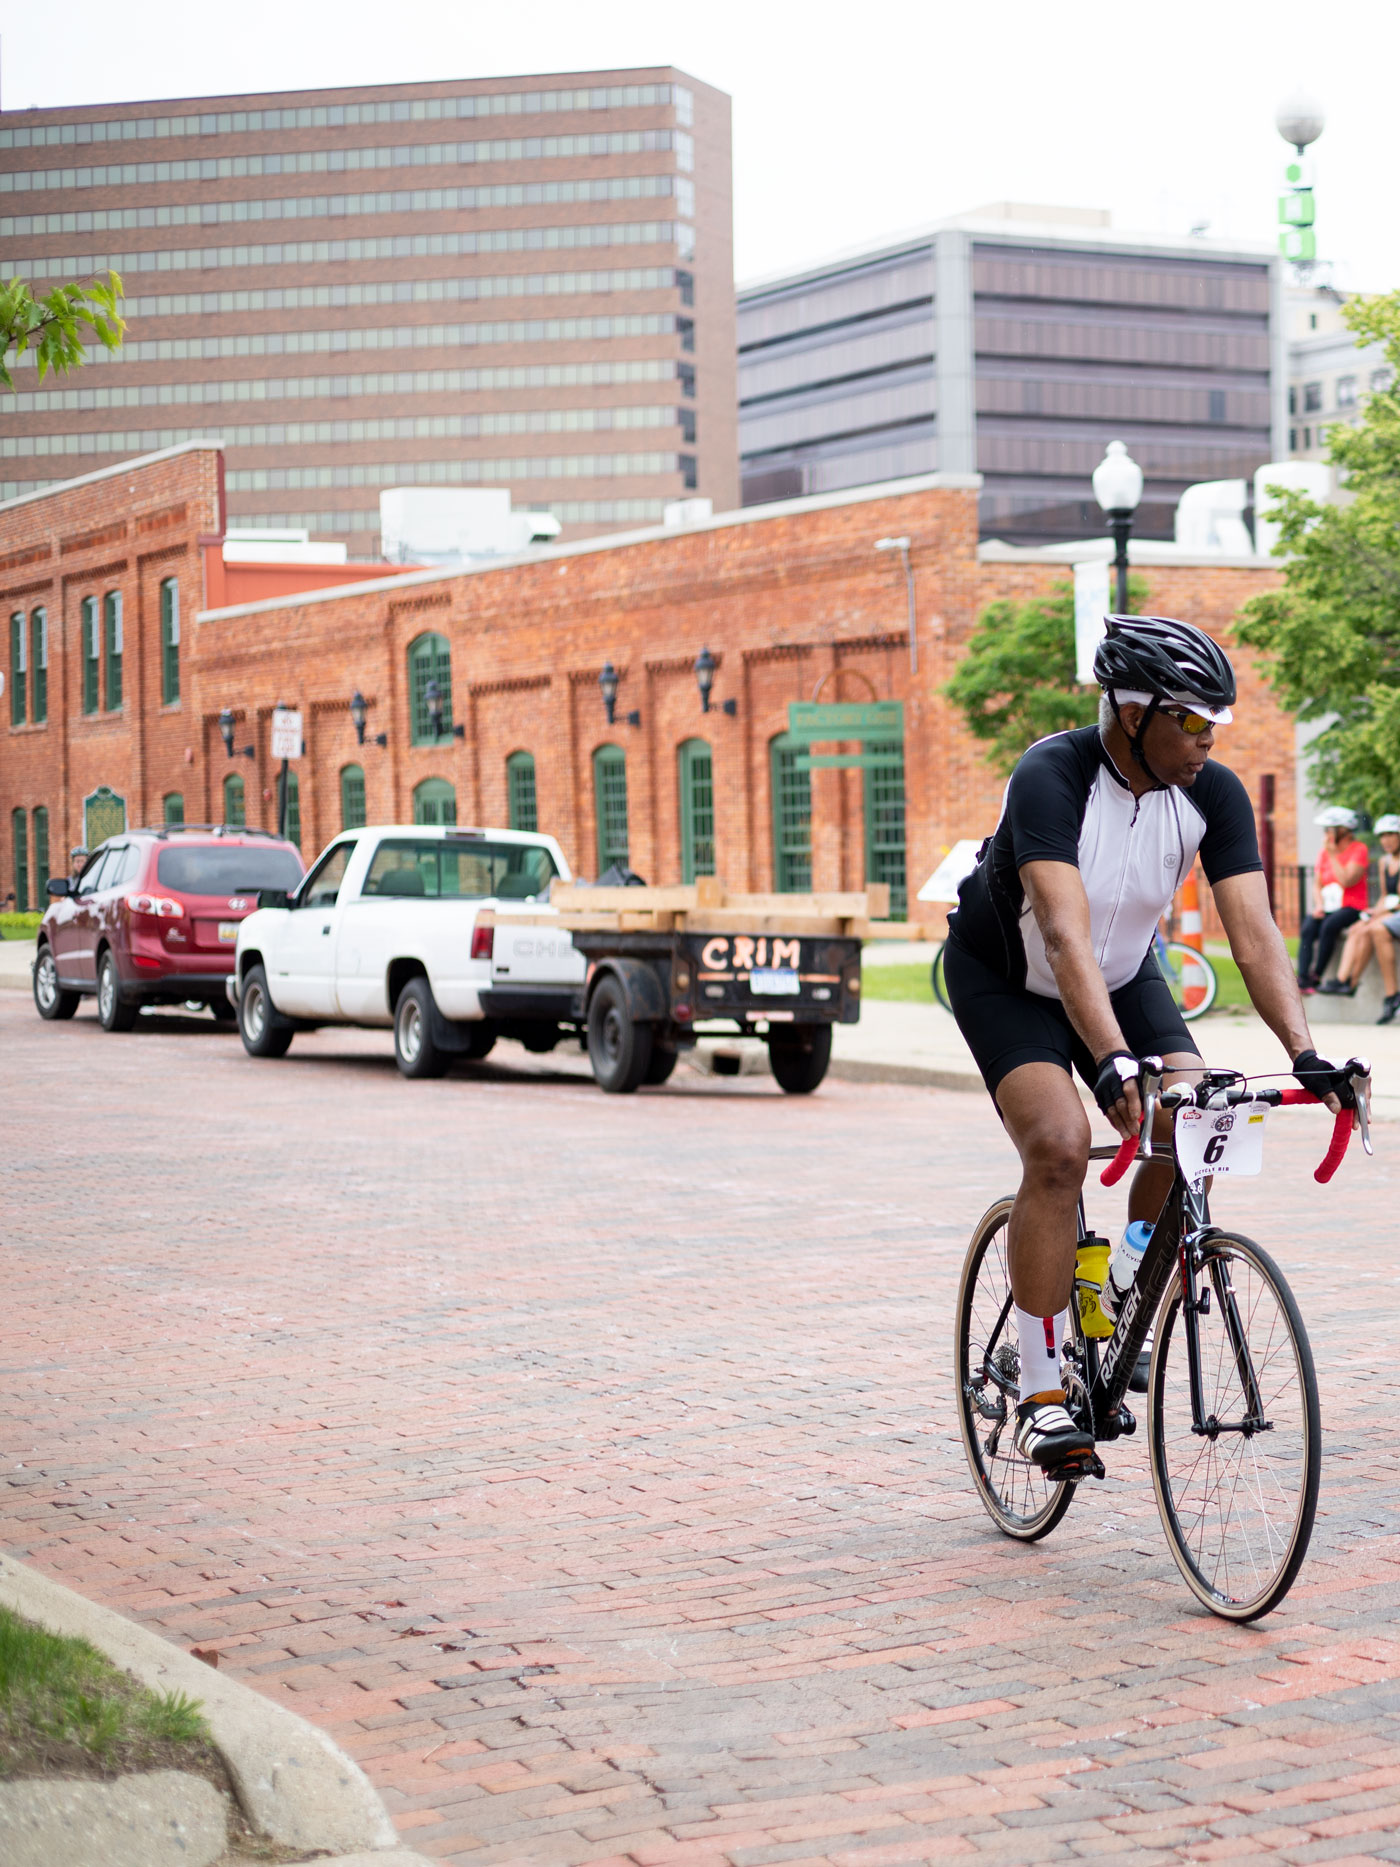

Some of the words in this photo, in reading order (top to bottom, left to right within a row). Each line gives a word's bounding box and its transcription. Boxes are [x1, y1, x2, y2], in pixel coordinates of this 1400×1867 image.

[701, 936, 801, 970] CRIM
[1203, 1134, 1228, 1164] 6
[1100, 1280, 1142, 1389] RALEIGH
